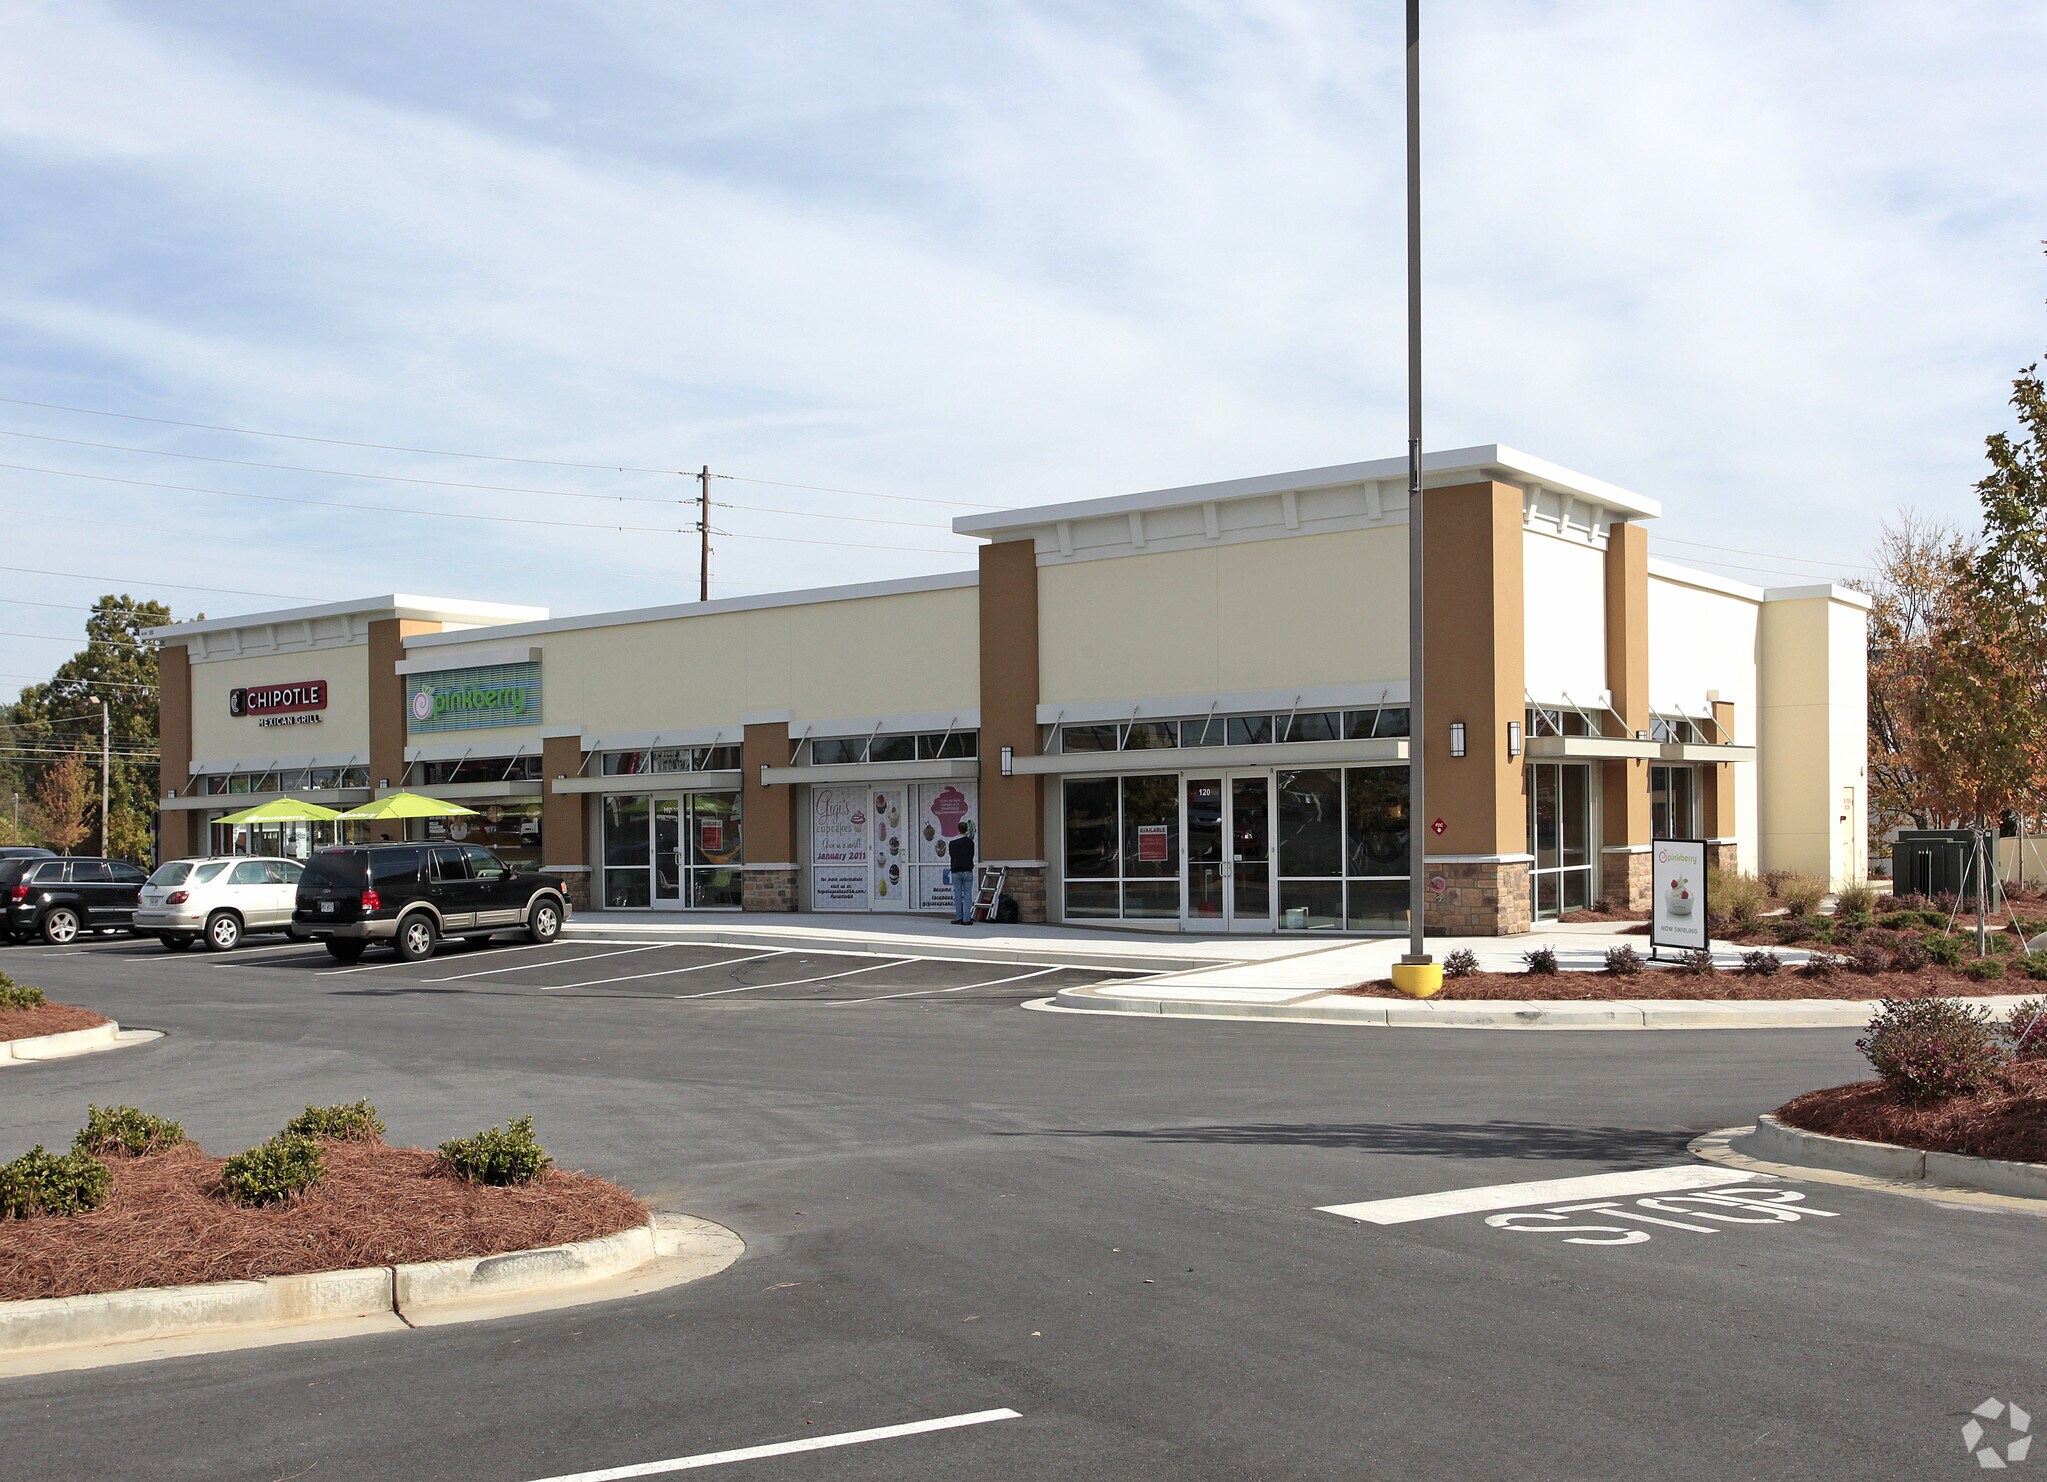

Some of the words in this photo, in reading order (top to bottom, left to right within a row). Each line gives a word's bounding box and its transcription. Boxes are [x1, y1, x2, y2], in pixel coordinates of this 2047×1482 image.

[247, 687, 319, 709] CHIPOTLE
[433, 683, 526, 719] pinkberry
[259, 717, 294, 727] MEXICAN
[296, 714, 320, 724] GRILL
[1199, 788, 1211, 796] 120
[816, 790, 849, 825] Gigi's
[816, 823, 852, 836] cupcakes
[817, 852, 847, 861] January
[849, 852, 866, 860] 2011
[1667, 853, 1697, 864] pinkberry
[1674, 926, 1698, 935] SWIRLING
[1484, 1186, 1841, 1246] STOP
